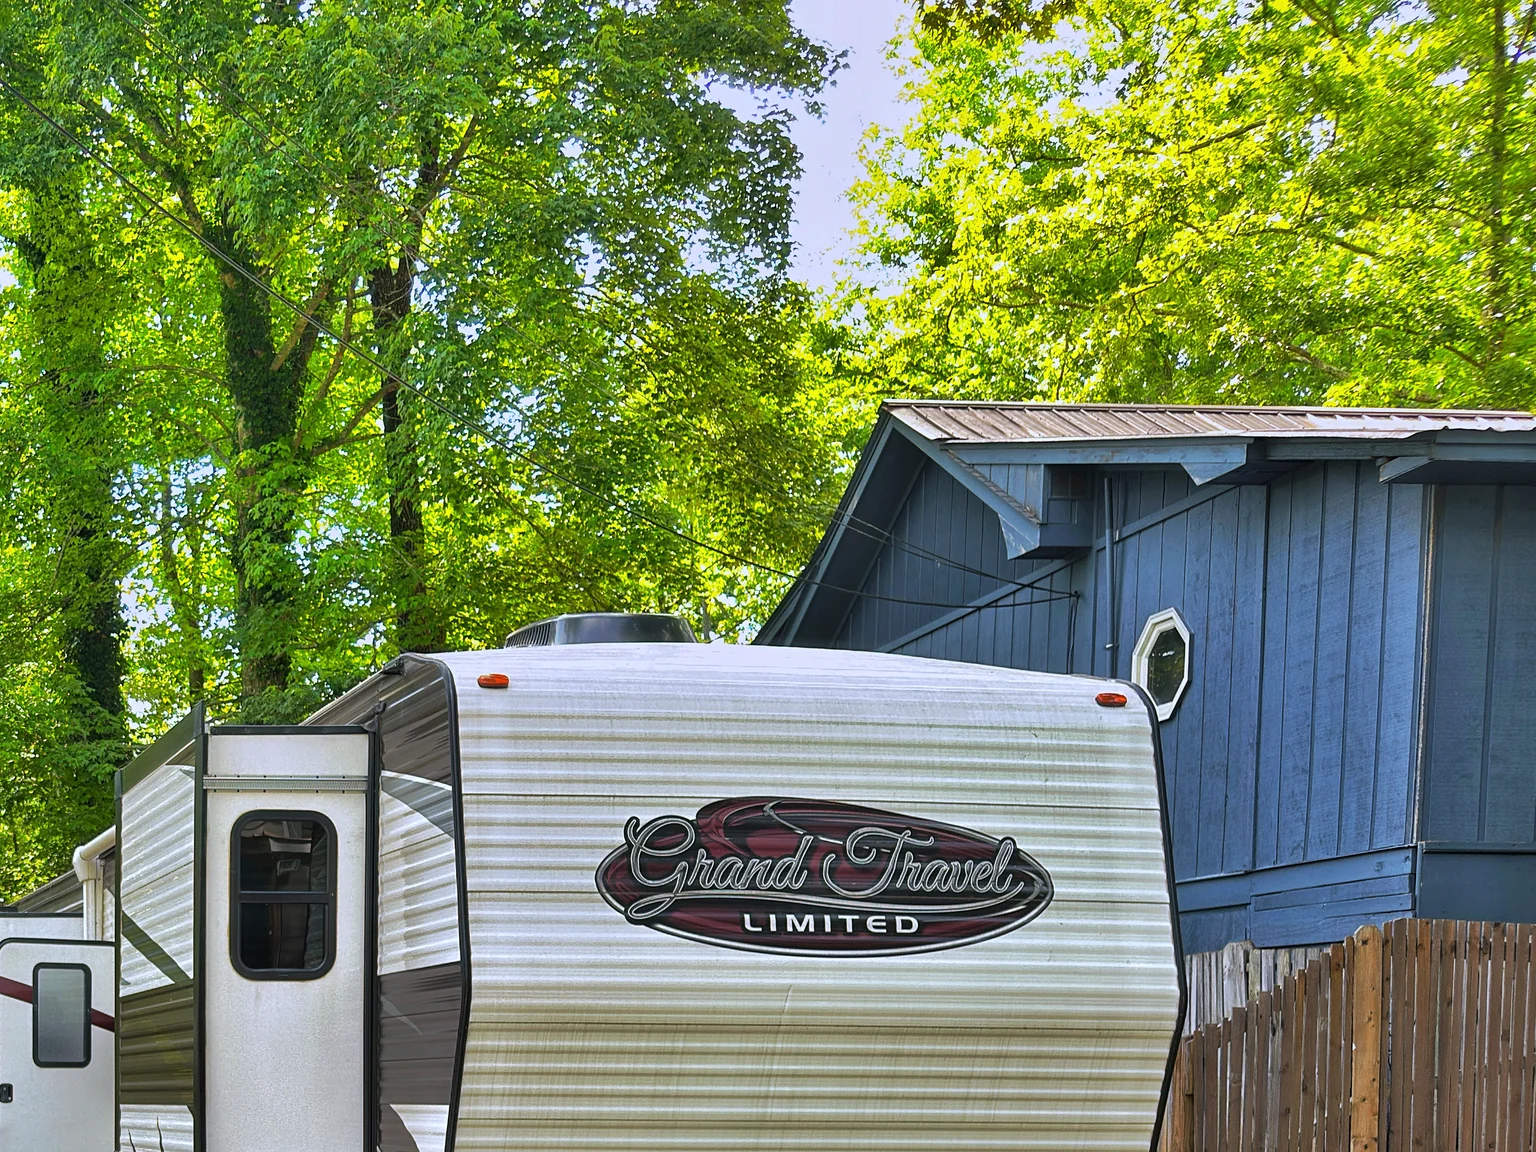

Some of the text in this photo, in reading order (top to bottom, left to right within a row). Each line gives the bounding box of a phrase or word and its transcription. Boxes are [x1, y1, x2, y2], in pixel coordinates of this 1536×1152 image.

[624, 815, 1025, 920] Grand Travel
[743, 912, 920, 935] LIMITED
